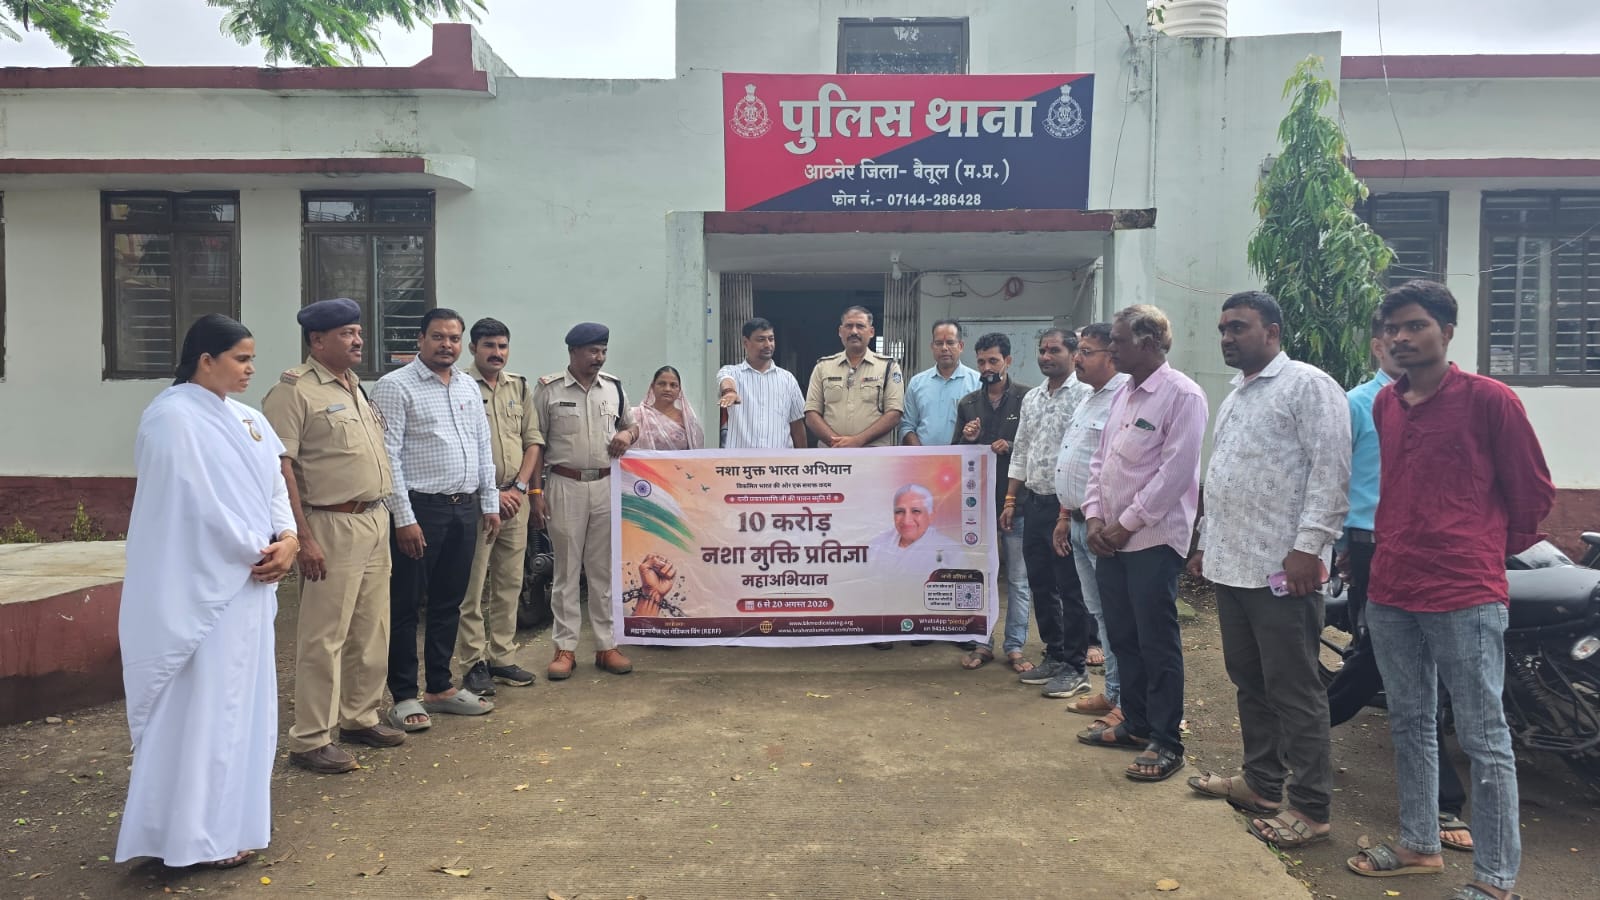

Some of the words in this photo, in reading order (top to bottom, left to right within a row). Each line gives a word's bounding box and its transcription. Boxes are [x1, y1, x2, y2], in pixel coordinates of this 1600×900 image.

[779, 82, 915, 155] पुलिस
[925, 97, 1037, 138] थाना
[804, 158, 855, 180] आठनेर
[913, 158, 949, 185] बैतूल
[955, 158, 1010, 185] (म.प्र.)
[832, 190, 856, 207] फोन
[887, 193, 981, 206] 07144-286428
[715, 466, 740, 477] नशा
[742, 466, 766, 480] मुक्त
[768, 465, 799, 476] भारत
[801, 461, 852, 476] अभियान
[738, 511, 766, 533] 10
[771, 506, 832, 537] करोड़
[700, 547, 747, 565] नशा
[749, 540, 800, 571] मुक्ति
[803, 539, 869, 564] प्रतिज्ञा
[741, 570, 829, 588] महाअभियान
[757, 601, 763, 609] 6
[763, 599, 771, 609] से
[772, 601, 783, 609] 20
[784, 600, 806, 609] अगस्त
[807, 600, 829, 609] 2026
